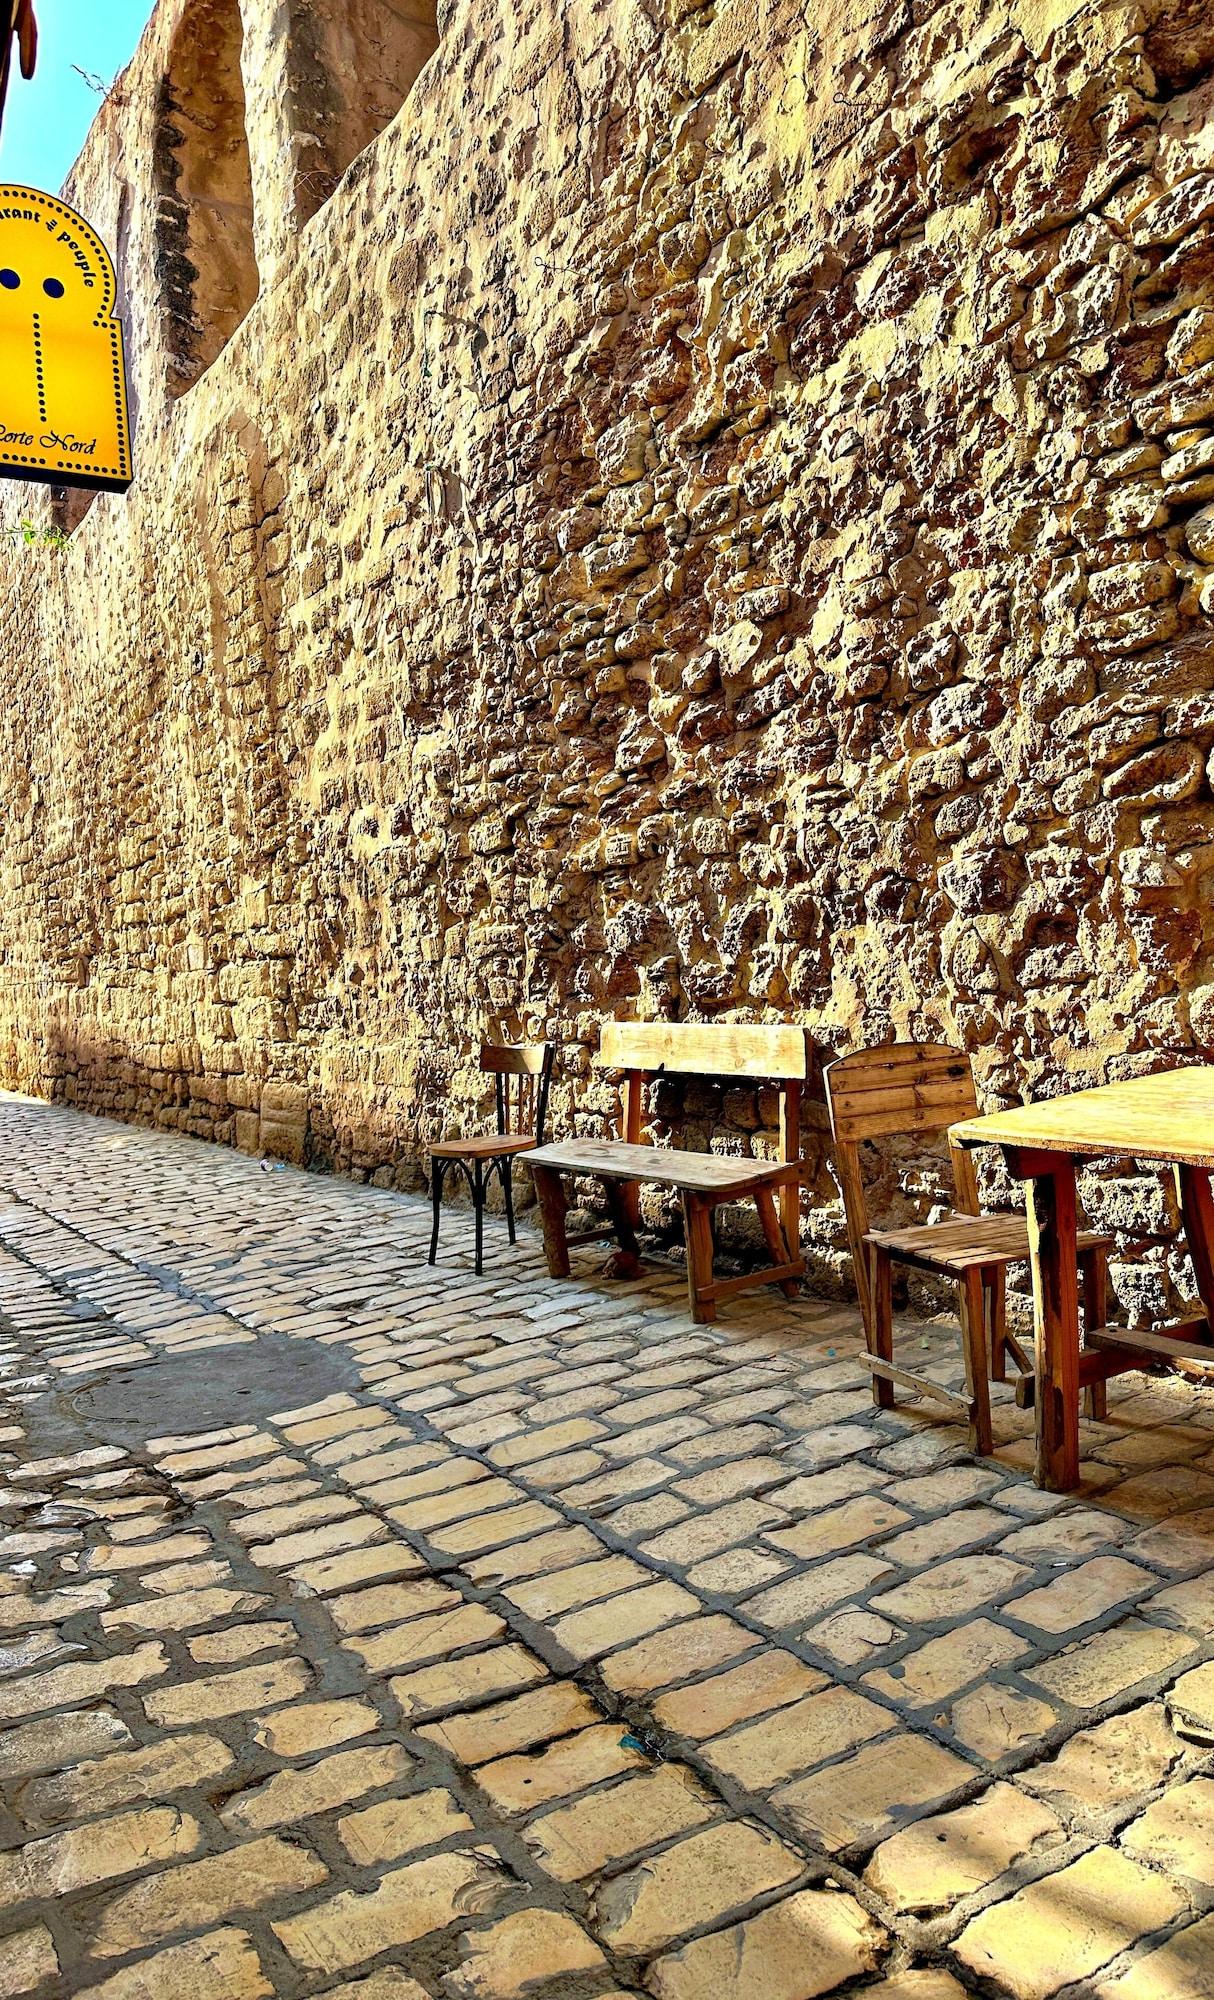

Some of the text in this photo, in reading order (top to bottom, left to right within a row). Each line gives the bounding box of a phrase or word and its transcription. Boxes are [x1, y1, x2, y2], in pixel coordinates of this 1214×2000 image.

[45, 219, 58, 232] du
[56, 231, 96, 287] peuple
[39, 430, 97, 455] Nord
